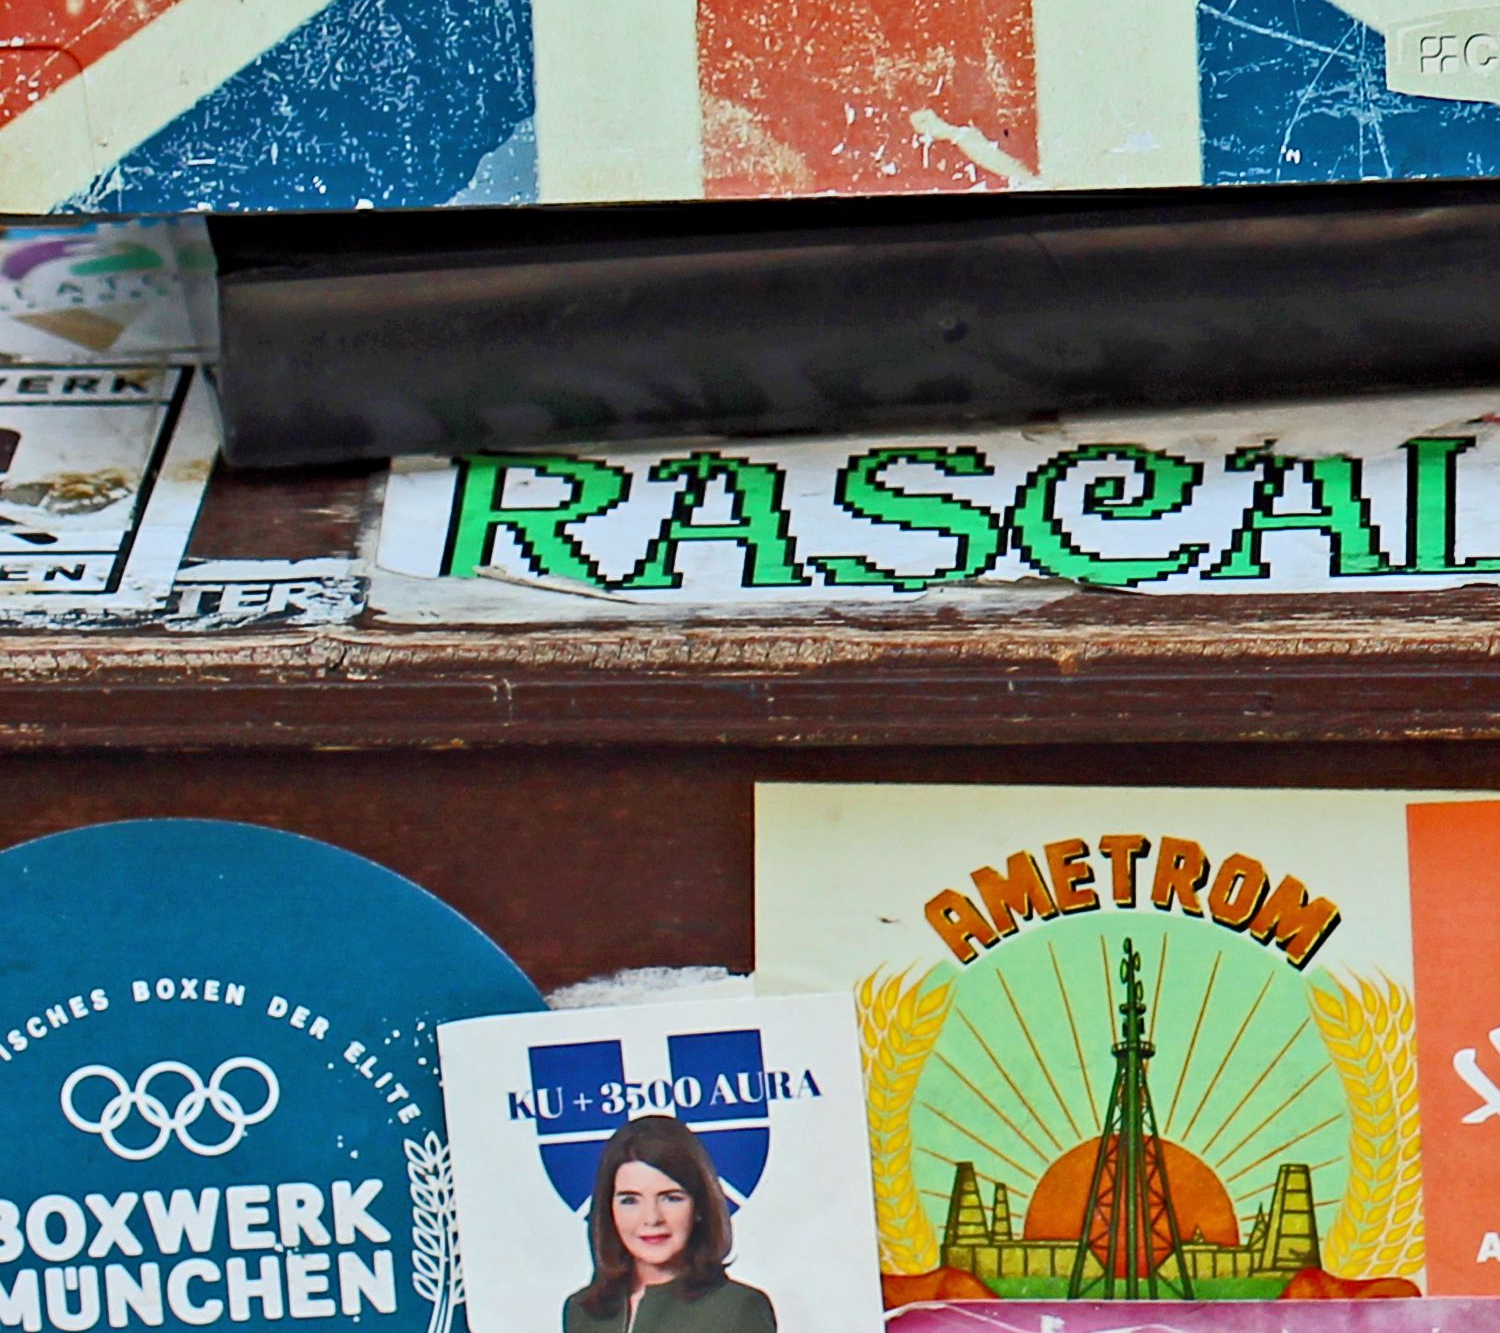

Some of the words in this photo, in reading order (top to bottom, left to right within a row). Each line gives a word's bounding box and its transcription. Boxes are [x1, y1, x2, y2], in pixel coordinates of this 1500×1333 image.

[0, 374, 151, 395] ERK
[921, 833, 1341, 969] AMETROM
[132, 977, 247, 1007] BOXEN
[267, 995, 331, 1041] DER
[343, 1040, 422, 1125] ELITE
[508, 1085, 565, 1122] KU
[599, 1075, 703, 1118] 3500
[708, 1067, 823, 1108] AURA
